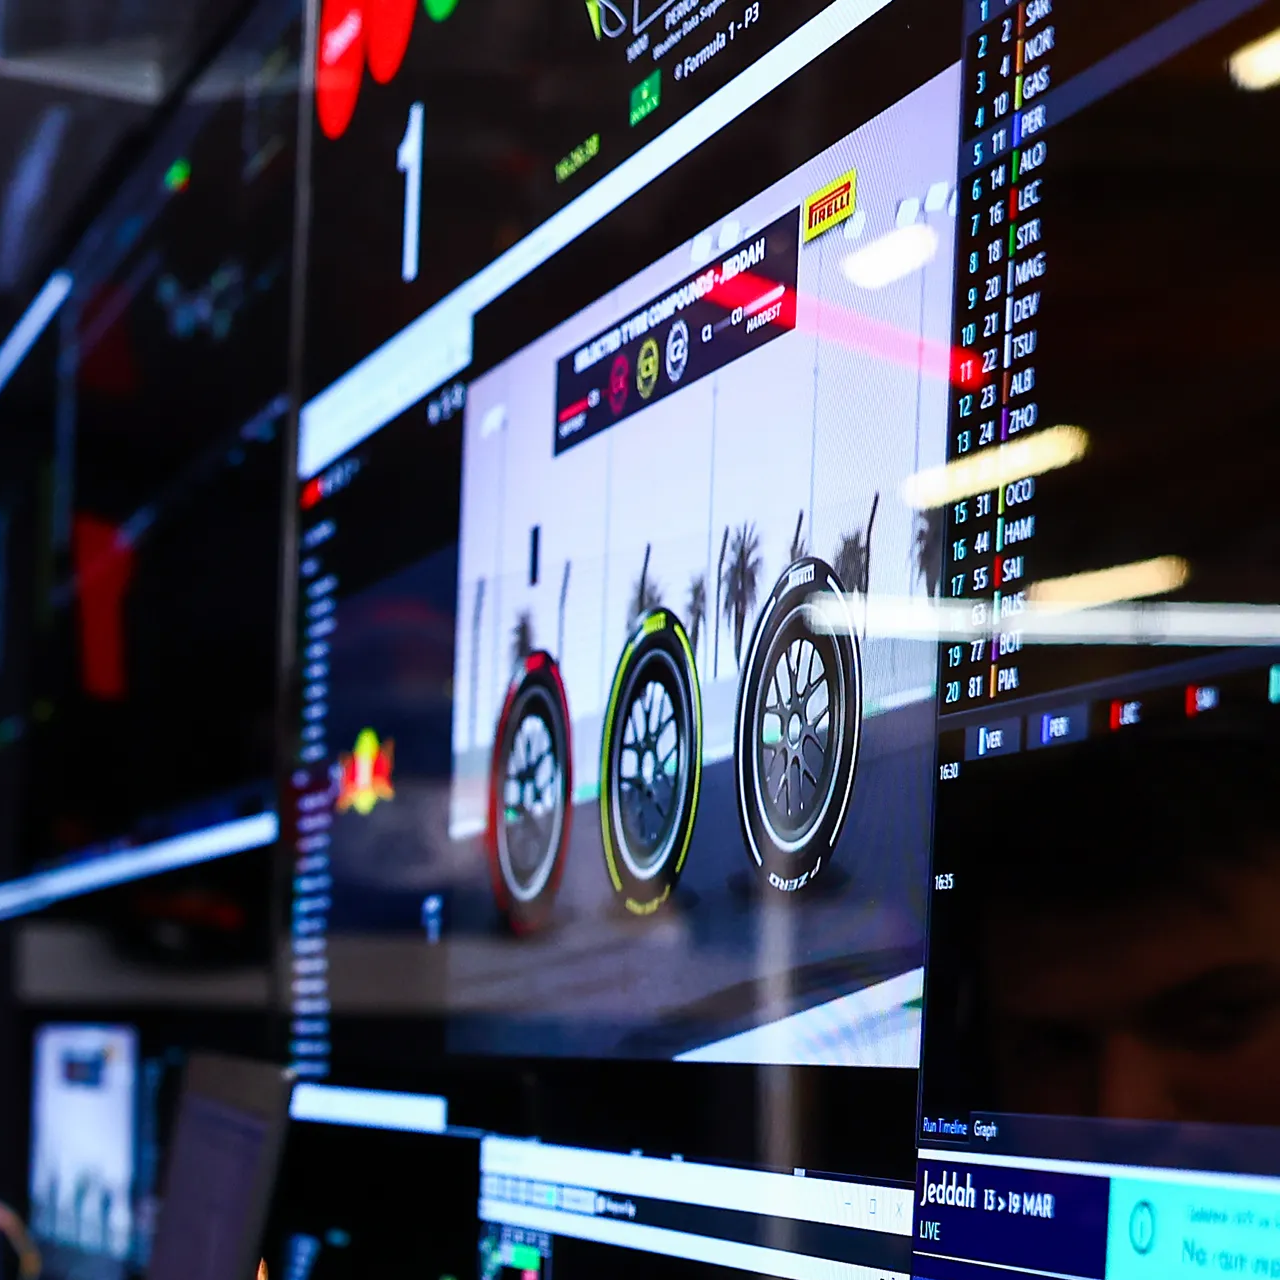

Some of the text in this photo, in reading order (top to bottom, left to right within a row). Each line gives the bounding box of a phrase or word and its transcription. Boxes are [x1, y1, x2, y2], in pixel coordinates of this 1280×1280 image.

[684, 32, 726, 77] Formula
[744, 2, 759, 28] P3
[976, 25, 1055, 94] 3 4 NOR
[978, 35, 988, 58] 2
[1001, 18, 1012, 42] 2
[974, 65, 1050, 128] 4 10 GAS
[973, 104, 1046, 165] 5 11 PER
[396, 101, 424, 283] 1
[972, 141, 1047, 201] 6 14 ALO
[808, 181, 851, 229] PIRELLI
[971, 179, 1042, 236] 7 16 LEC
[720, 237, 766, 285] JEDDAH
[969, 217, 1040, 273] 8 18 STR
[968, 251, 1046, 310] 9 20 MAG
[746, 302, 782, 334] HARDEST
[962, 323, 976, 347] 10
[983, 312, 998, 337] 21
[960, 328, 1037, 382] 11 22 TSU
[959, 367, 1035, 418] 12 23 ALB
[957, 402, 1038, 453] 13 24 ZHO
[954, 477, 1035, 524] 15 31 OCO
[953, 515, 1035, 561] 16 44 HAM
[951, 556, 1024, 596] 17 55 SAI
[972, 603, 986, 626] 63
[948, 629, 1024, 667] 19 77 BOT
[945, 667, 1019, 703] 20 81 PIA
[768, 871, 809, 891] ZERO
[923, 1117, 937, 1132] Run
[974, 1120, 998, 1141] Graph
[920, 1170, 976, 1208] Jeddah
[1008, 1191, 1022, 1214] 19
[1023, 1192, 1055, 1218] MAR
[920, 1220, 941, 1241] LIVE
